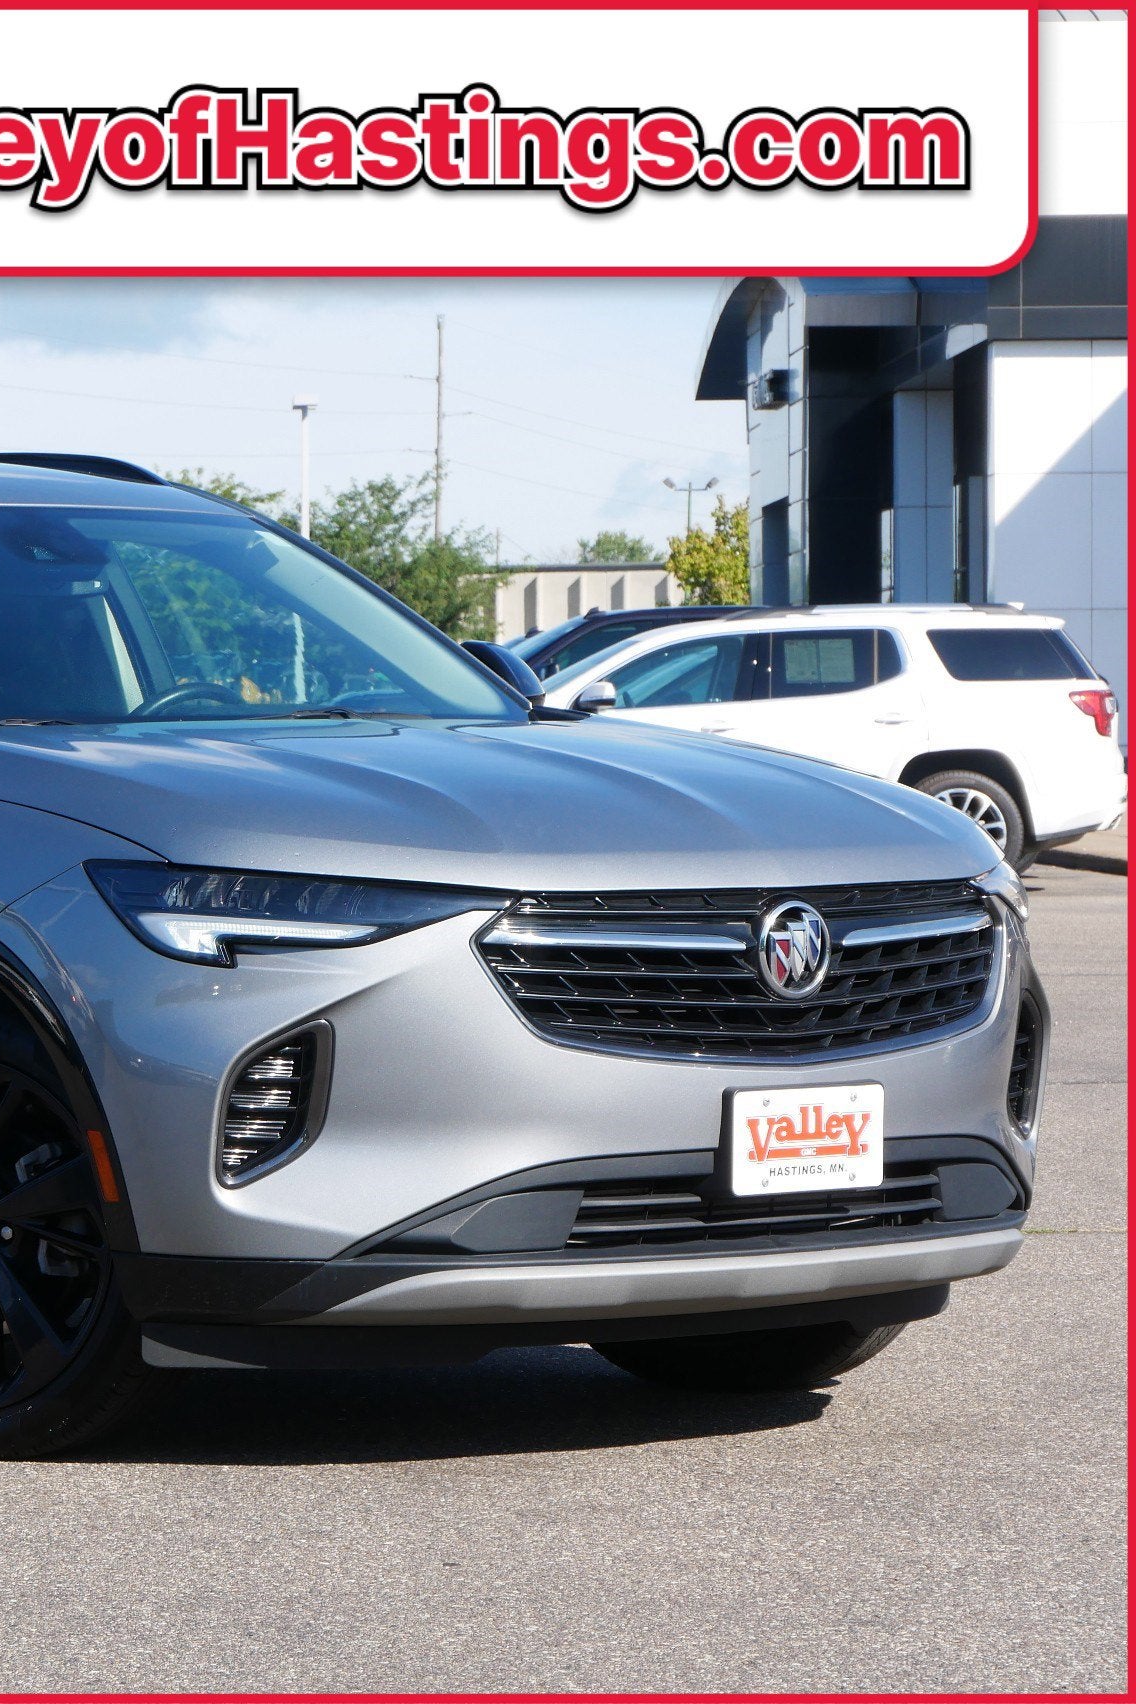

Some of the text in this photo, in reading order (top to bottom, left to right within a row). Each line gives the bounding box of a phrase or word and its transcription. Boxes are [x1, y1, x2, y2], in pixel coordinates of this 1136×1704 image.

[746, 1105, 872, 1163] Valley
[800, 1147, 817, 1157] GMC
[769, 1163, 848, 1177] HASTINGS, MN.
